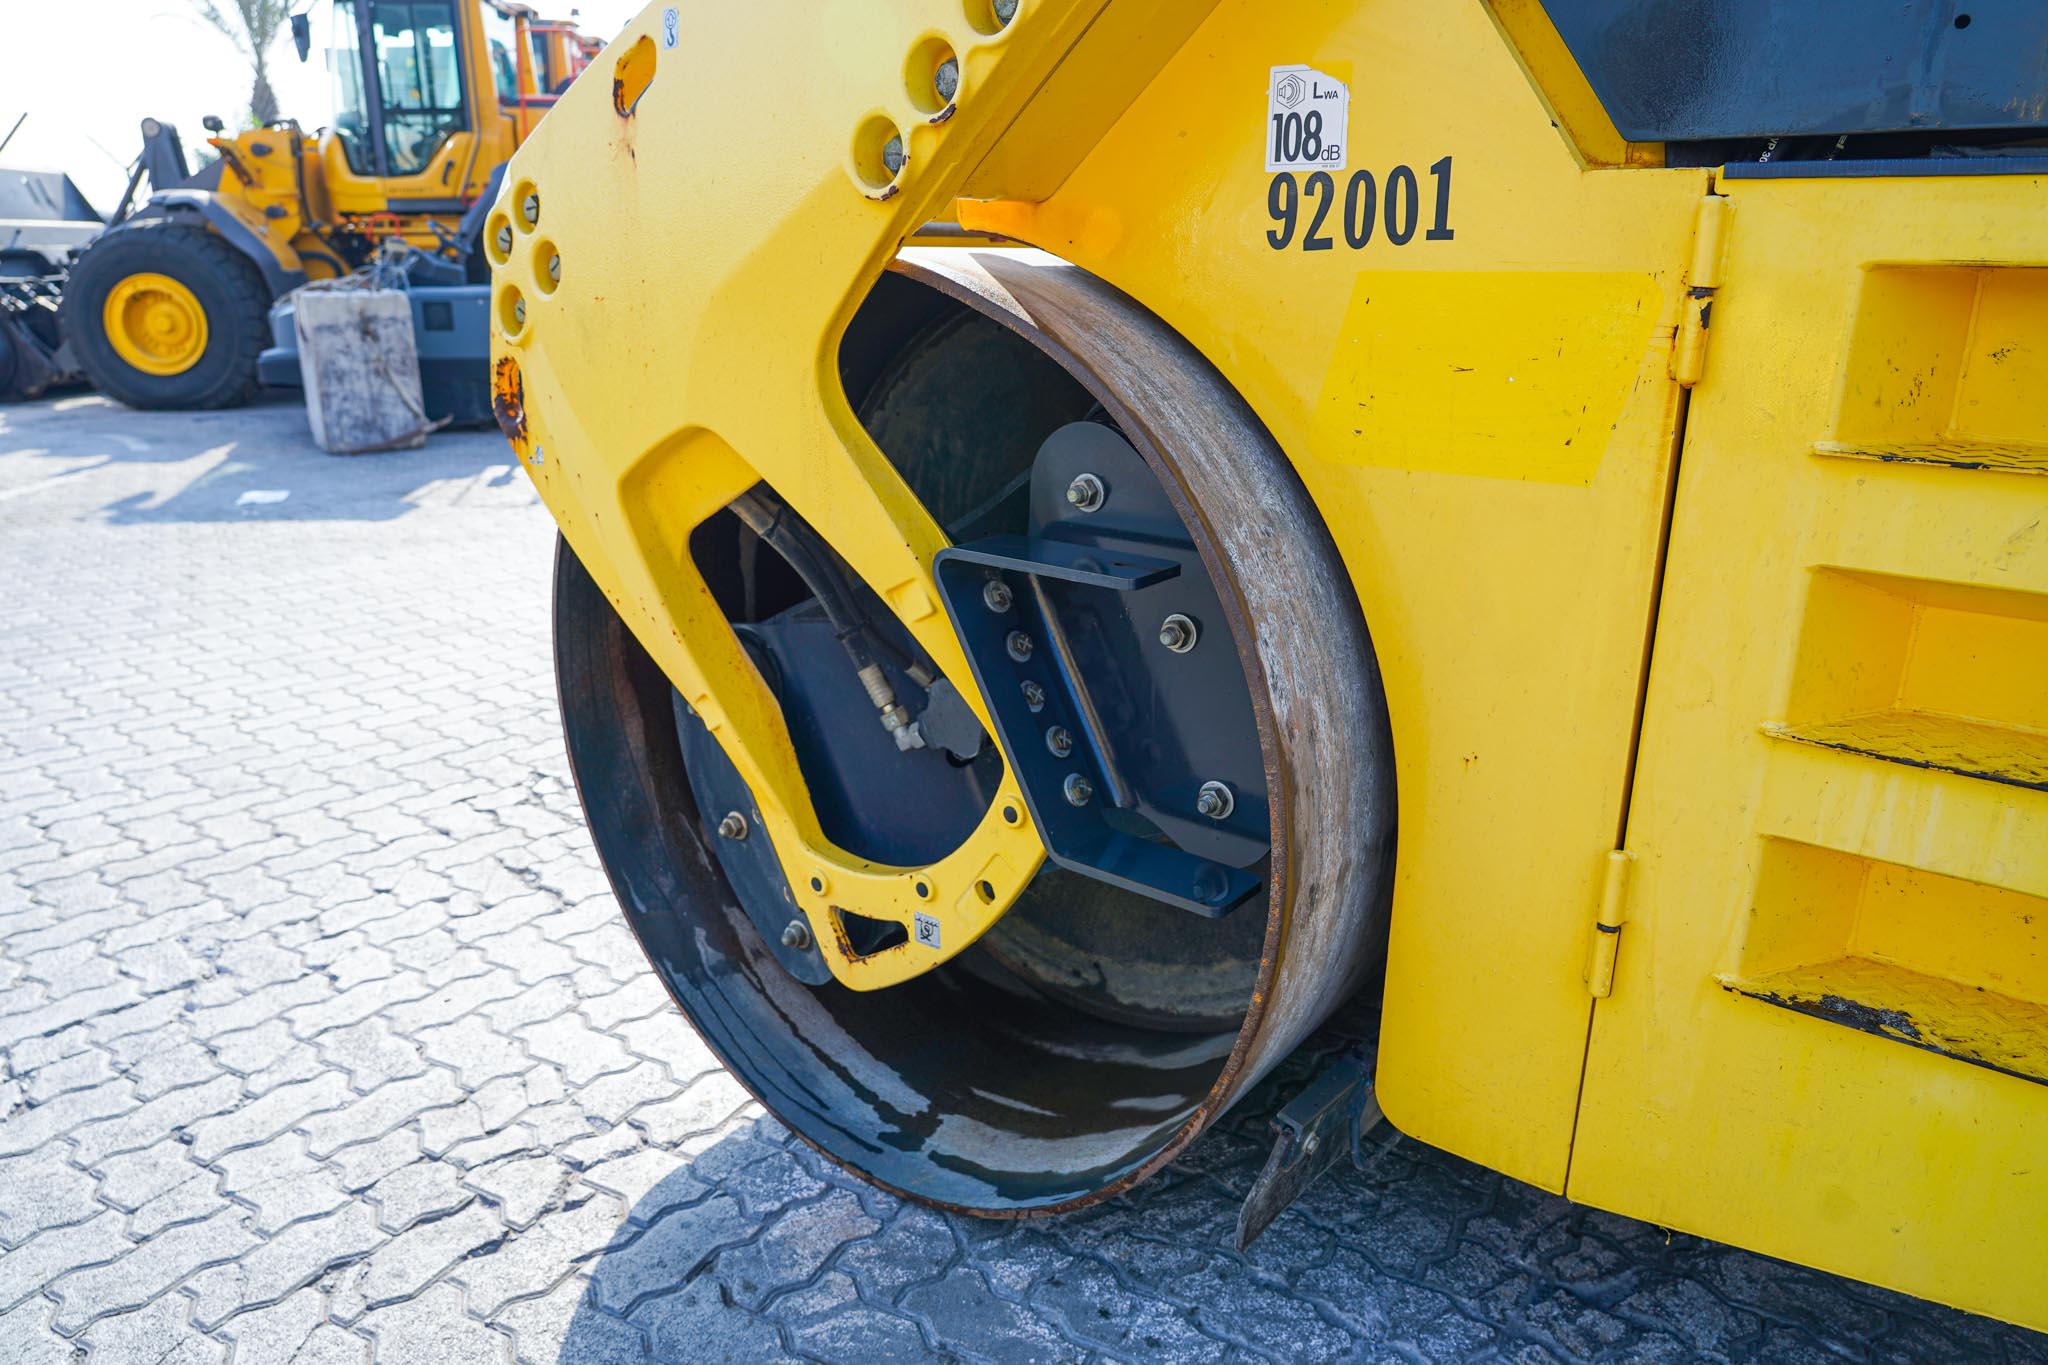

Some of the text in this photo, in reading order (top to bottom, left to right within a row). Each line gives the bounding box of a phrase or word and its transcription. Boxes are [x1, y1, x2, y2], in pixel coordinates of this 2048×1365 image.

[1312, 81, 1339, 100] LWA
[1272, 109, 1341, 163] 108 dB
[1265, 155, 1455, 252] 92001
